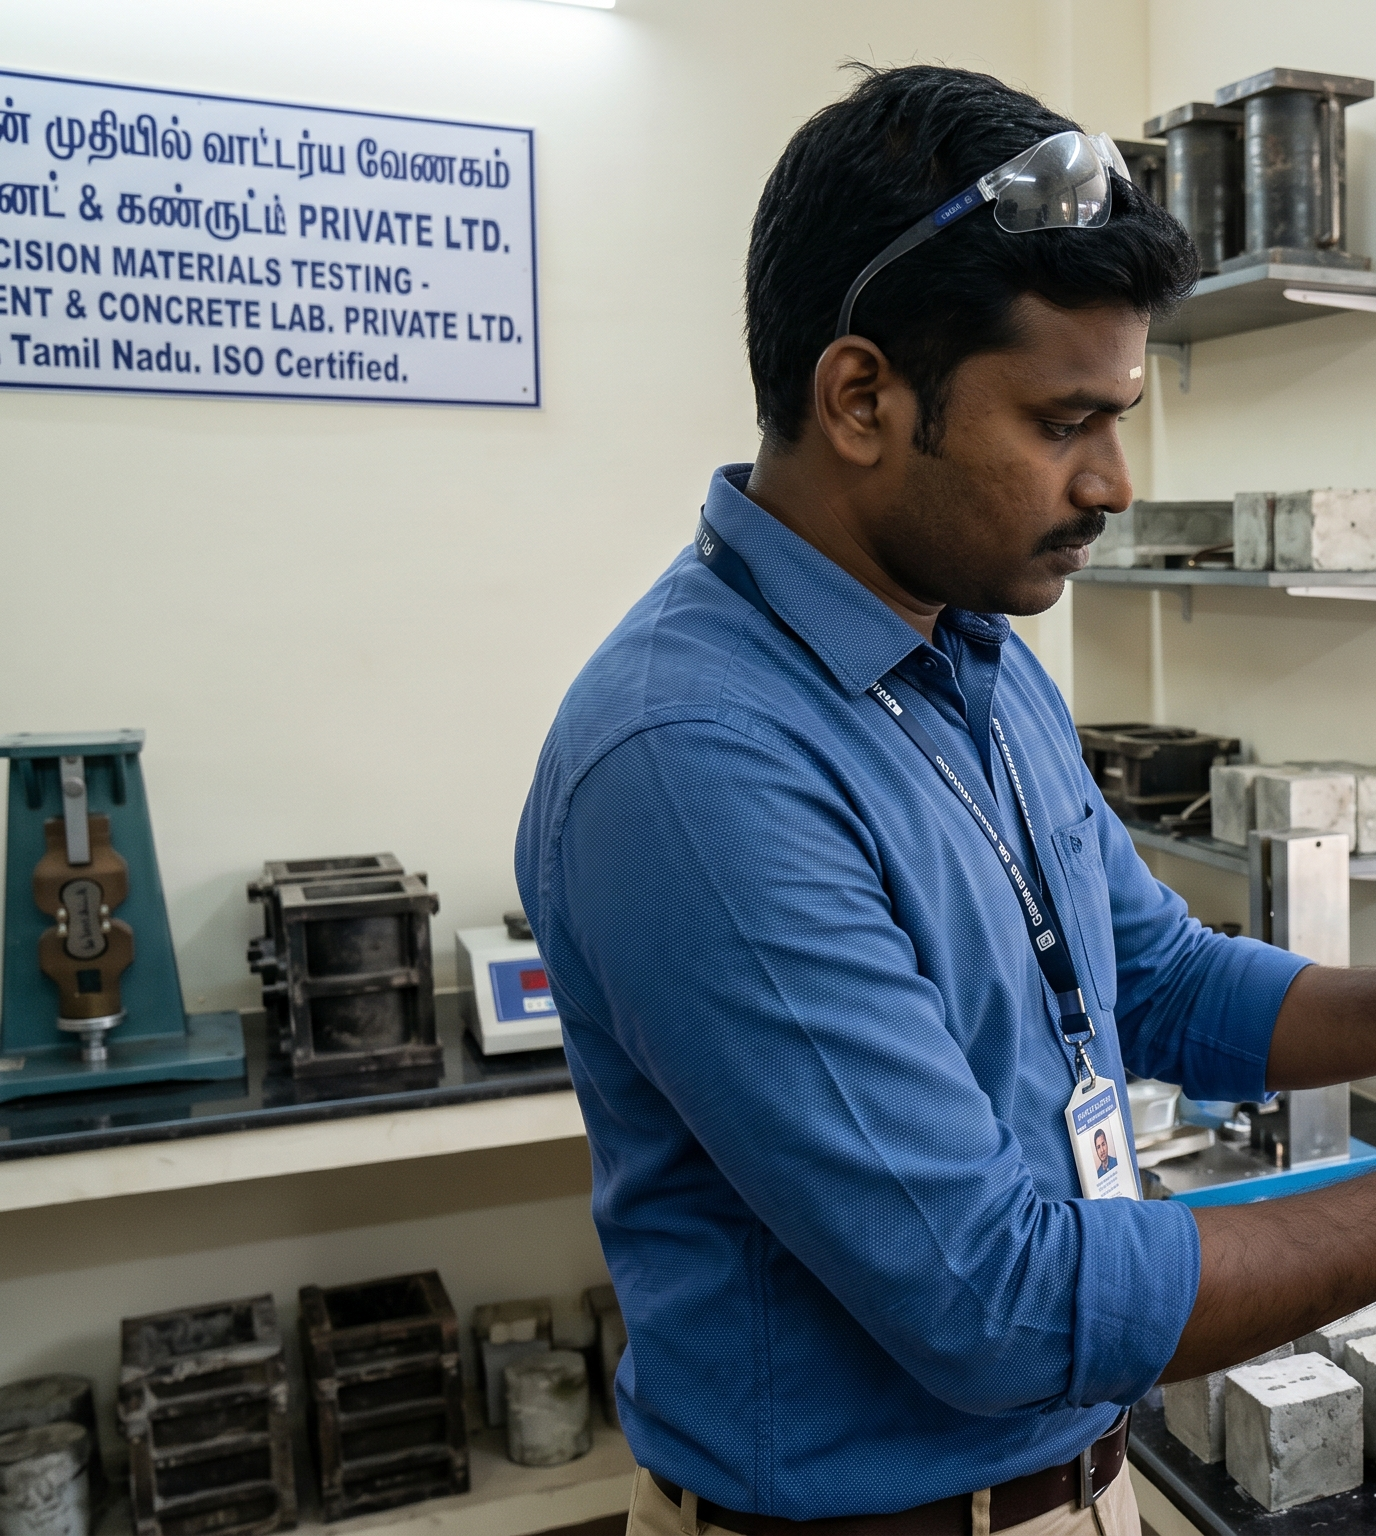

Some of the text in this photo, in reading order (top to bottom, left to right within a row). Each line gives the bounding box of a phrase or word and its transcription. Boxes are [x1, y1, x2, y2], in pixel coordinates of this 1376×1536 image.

[357, 138, 510, 189] வேணகம்
[79, 184, 103, 221] &
[299, 204, 434, 248] PRIVATE
[446, 215, 510, 253] LTD.
[112, 246, 281, 286] MATERIALS
[292, 260, 412, 294] TESTING
[66, 289, 86, 319] &
[98, 291, 261, 329] CONCRETE
[271, 302, 334, 333] LAB.
[345, 306, 458, 340] PRIVATE
[468, 313, 523, 344] LTD.
[11, 333, 408, 382] Tamil Nadu. ISO Certified.
